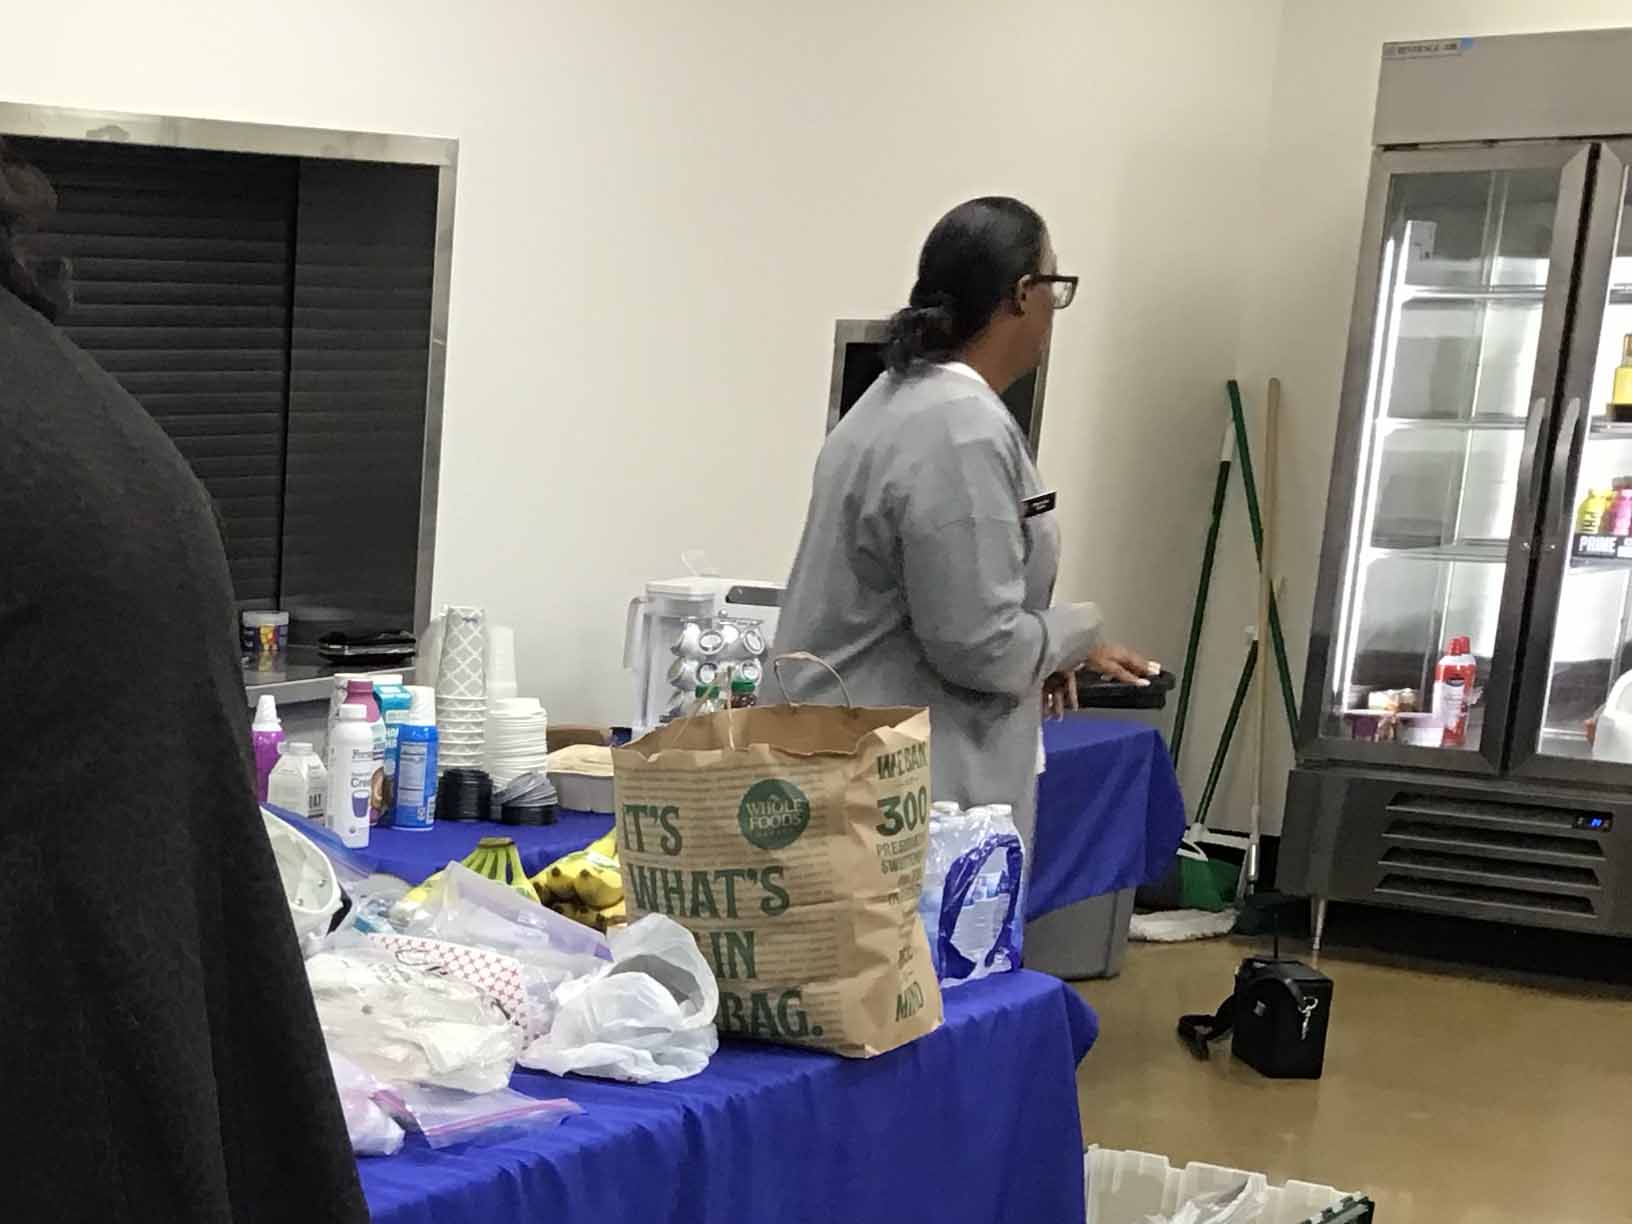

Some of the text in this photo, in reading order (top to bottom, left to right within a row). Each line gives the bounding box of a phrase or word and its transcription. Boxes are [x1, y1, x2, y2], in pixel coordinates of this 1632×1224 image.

[623, 804, 682, 856] IT'S
[747, 798, 801, 816] WHOLE
[749, 813, 801, 832] FOODS
[875, 785, 928, 837] 300
[627, 863, 790, 919] WHAT'S
